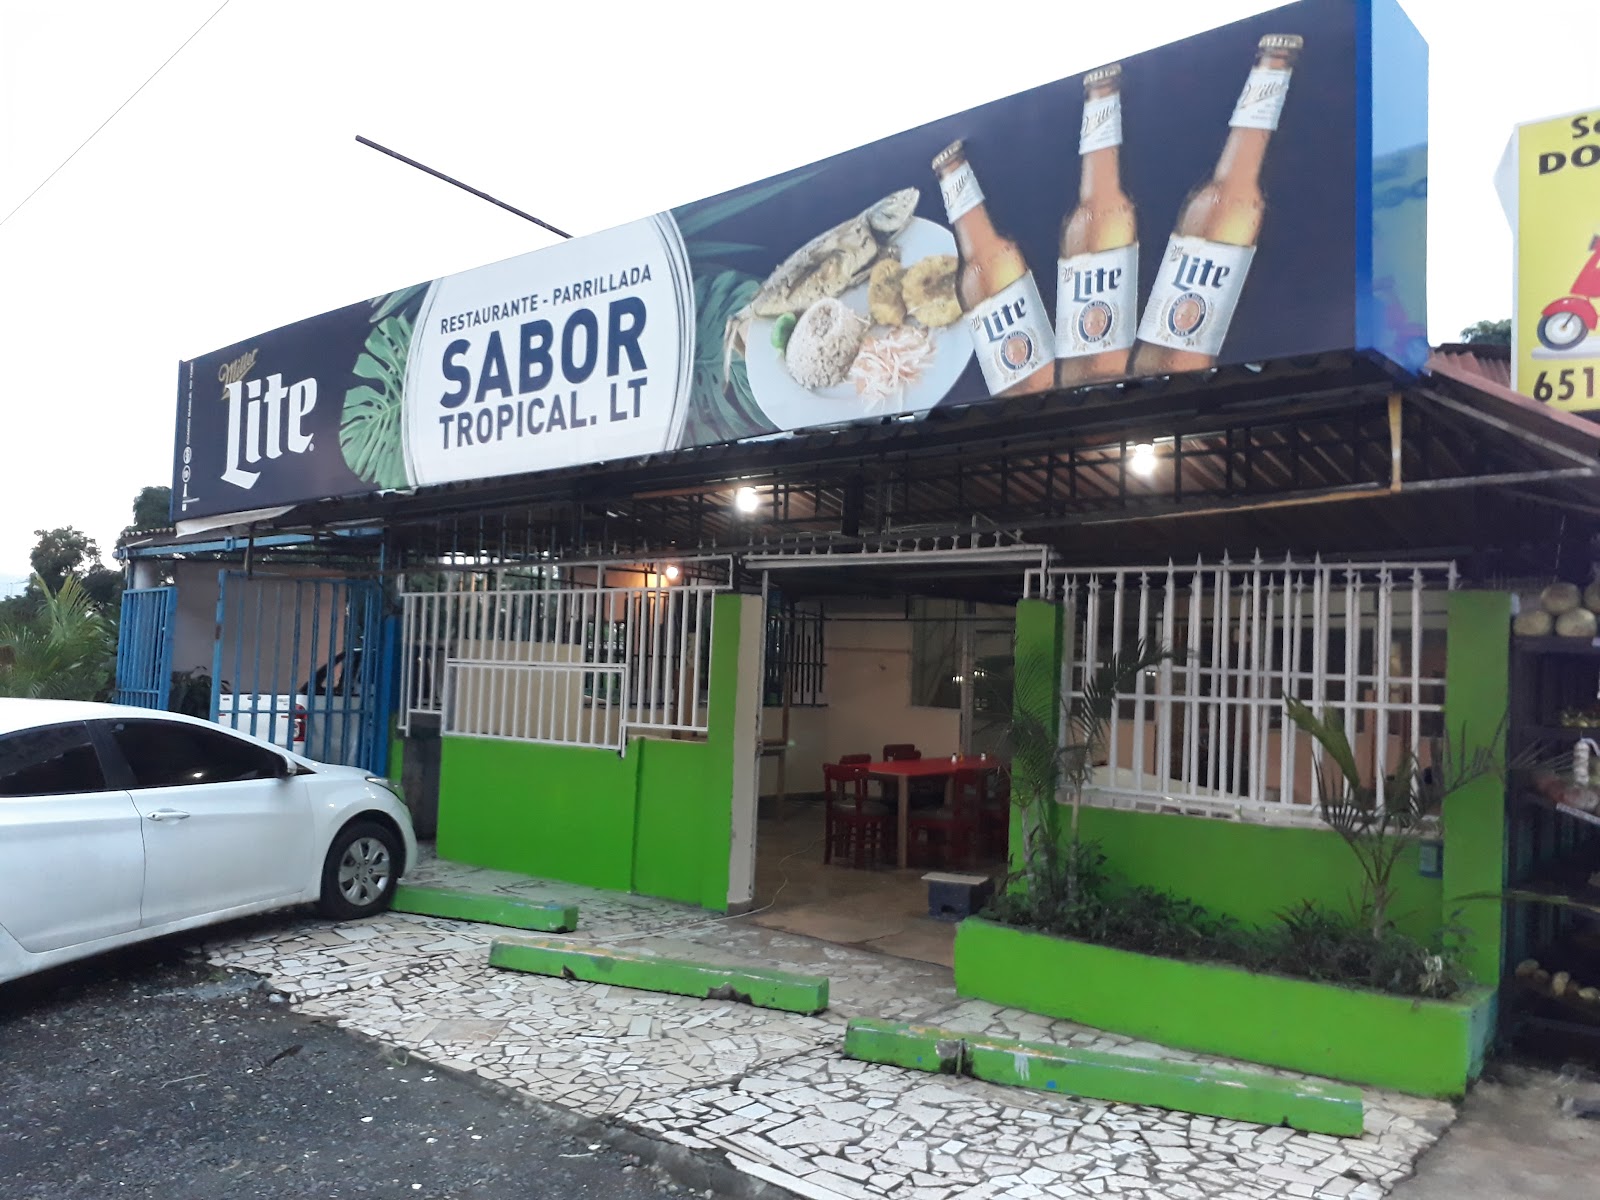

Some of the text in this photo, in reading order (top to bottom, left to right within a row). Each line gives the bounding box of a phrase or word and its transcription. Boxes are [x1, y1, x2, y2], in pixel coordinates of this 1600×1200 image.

[1073, 267, 1122, 302] Lite
[1172, 254, 1230, 292] Lite
[440, 294, 539, 335] RESTAURANTE
[553, 264, 652, 306] PARRILLADA
[982, 297, 1027, 343] Lite
[218, 348, 259, 400] Miller
[439, 296, 648, 409] SABOR
[1533, 366, 1594, 402] 651
[439, 376, 648, 450] TROPICAL. LT
